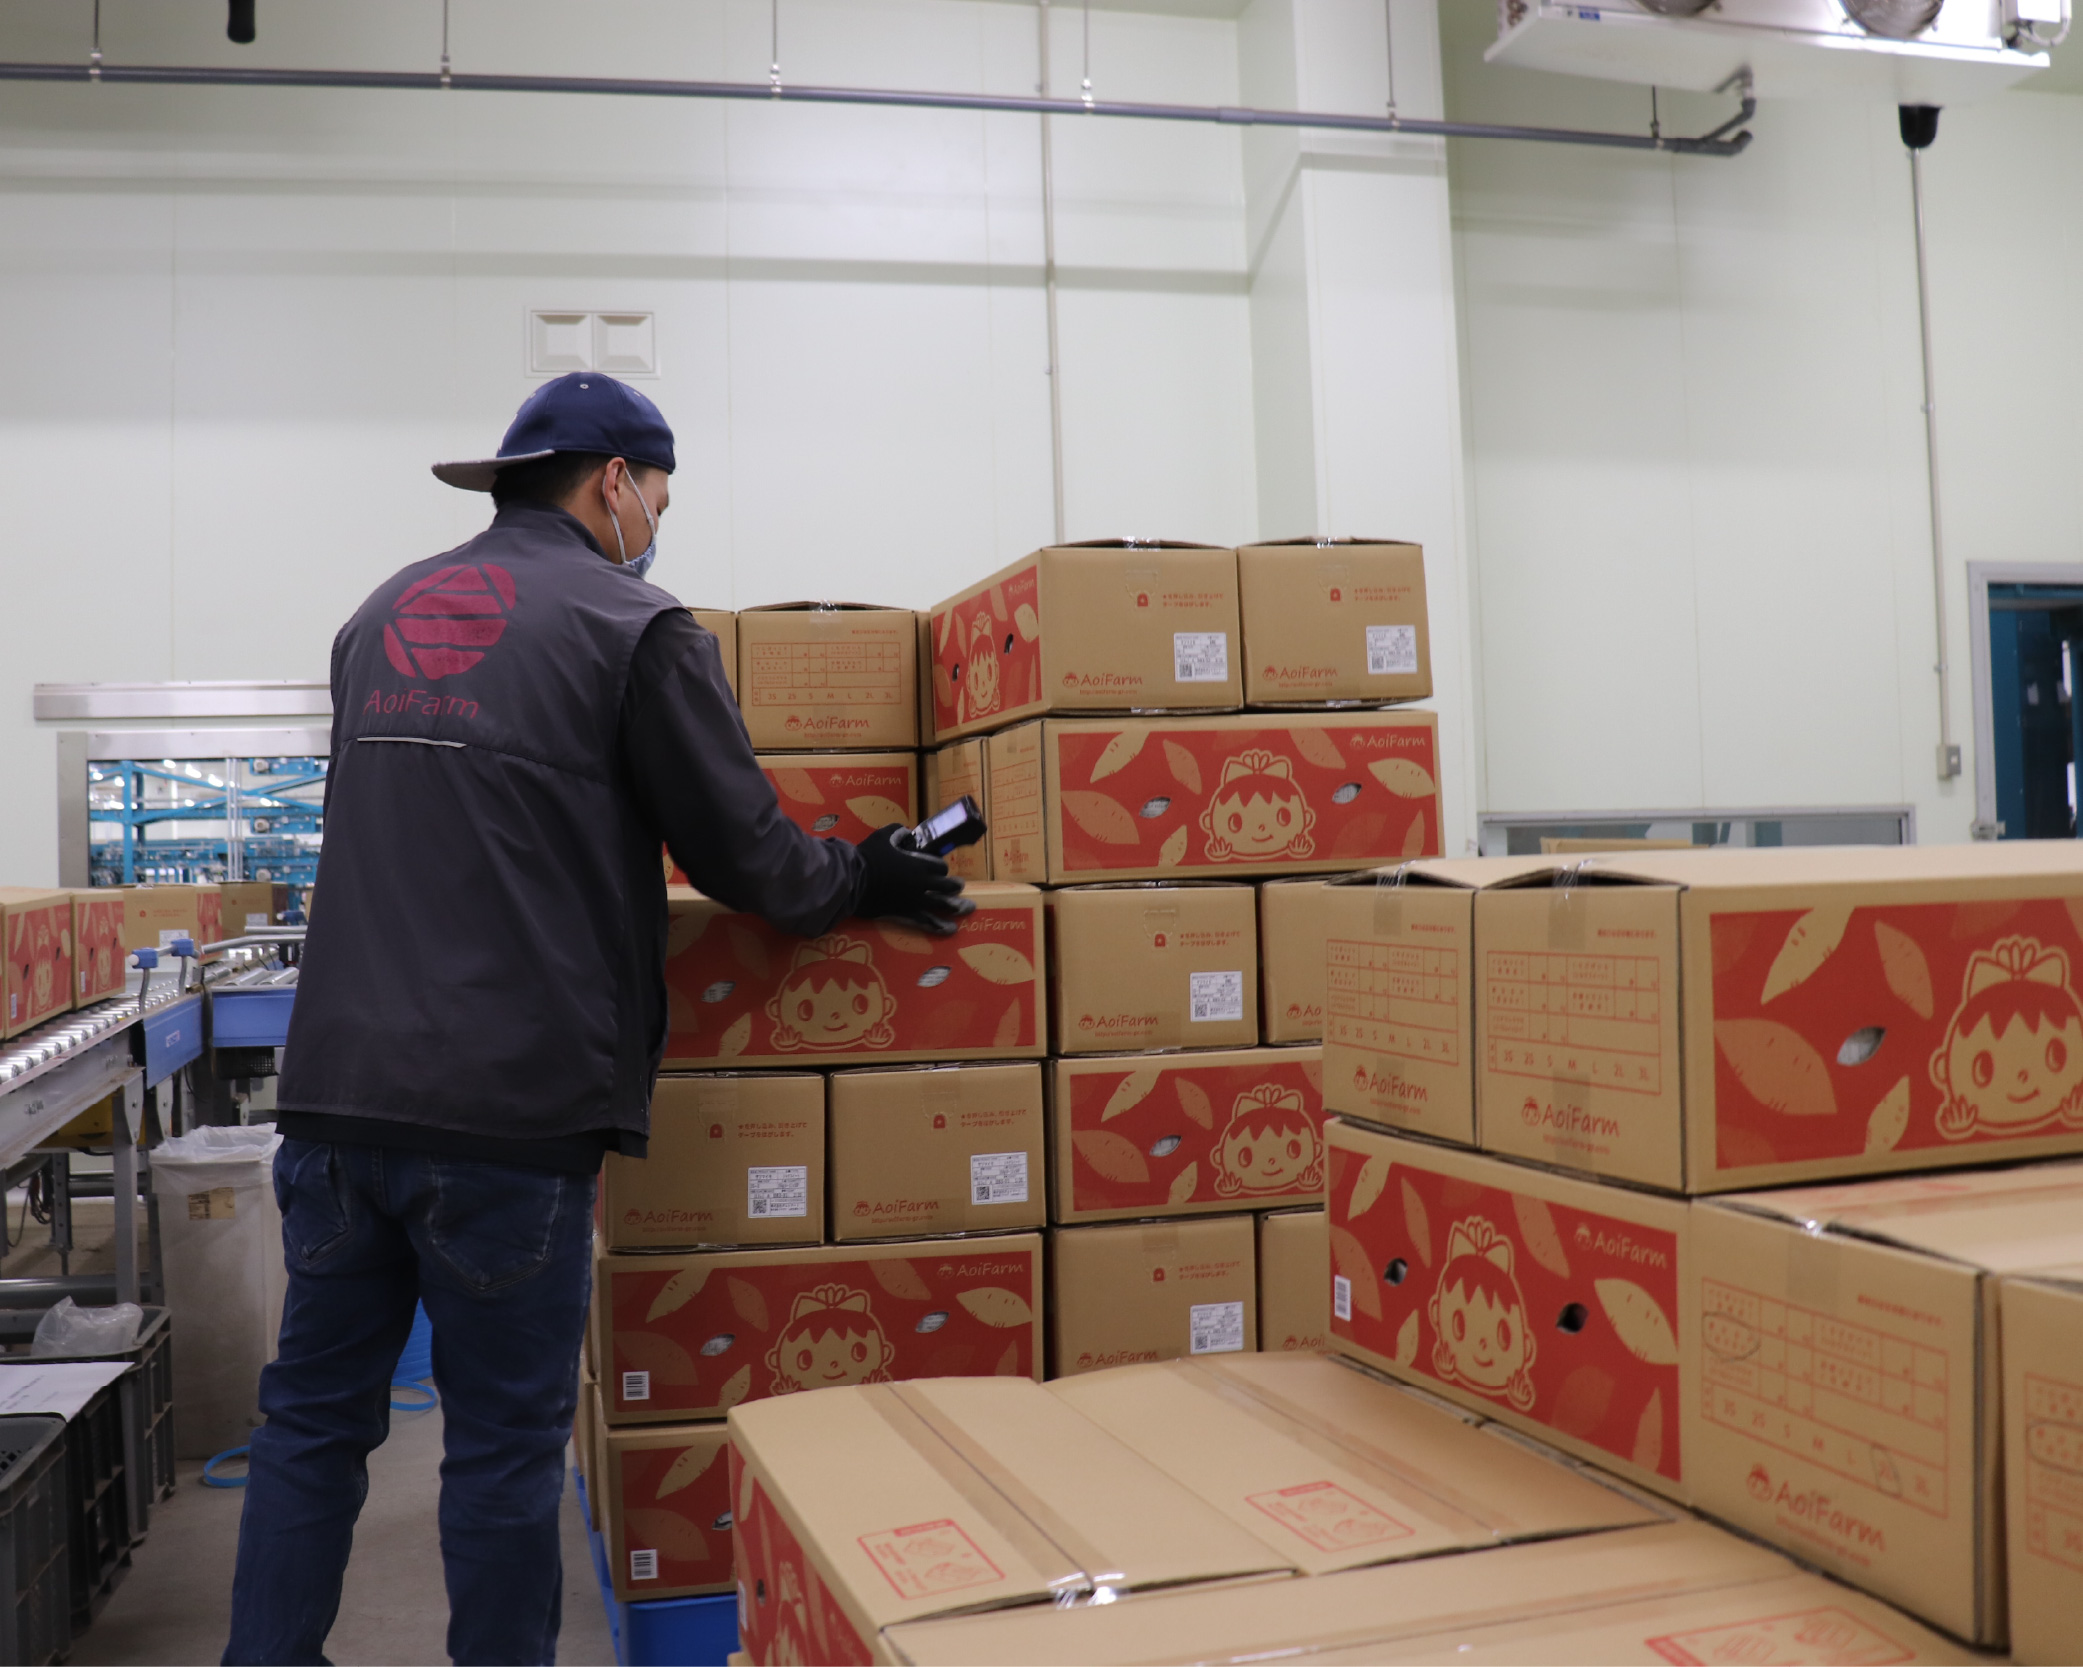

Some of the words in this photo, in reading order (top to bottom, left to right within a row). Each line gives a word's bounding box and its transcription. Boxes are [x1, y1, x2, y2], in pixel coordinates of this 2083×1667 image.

[1081, 673, 1143, 687] AoiFarm
[1280, 666, 1338, 680] AoiFarm
[362, 688, 480, 719] AoiFarm
[788, 692, 797, 700] 2S
[808, 692, 814, 700] S
[827, 692, 835, 700] M
[803, 716, 870, 730] AoiFarm
[1366, 733, 1426, 748] AoiFarm
[845, 774, 902, 787] AoiFarm
[958, 918, 1026, 933] AoiFarm
[1303, 1004, 1322, 1018] Ao
[1097, 1014, 1159, 1029] AoiFarm
[1567, 1059, 1578, 1071] M
[1369, 1072, 1429, 1103] AoiFarm
[1542, 1103, 1621, 1138] AoiFarm
[873, 1200, 940, 1215] AoiFarm
[643, 1208, 714, 1224] AoiFarm
[1593, 1231, 1668, 1270] AoiFarm
[956, 1262, 1024, 1277] AoiFarm
[1095, 1350, 1159, 1366] AoiFarm
[1775, 1481, 1888, 1552] AoiFarm
